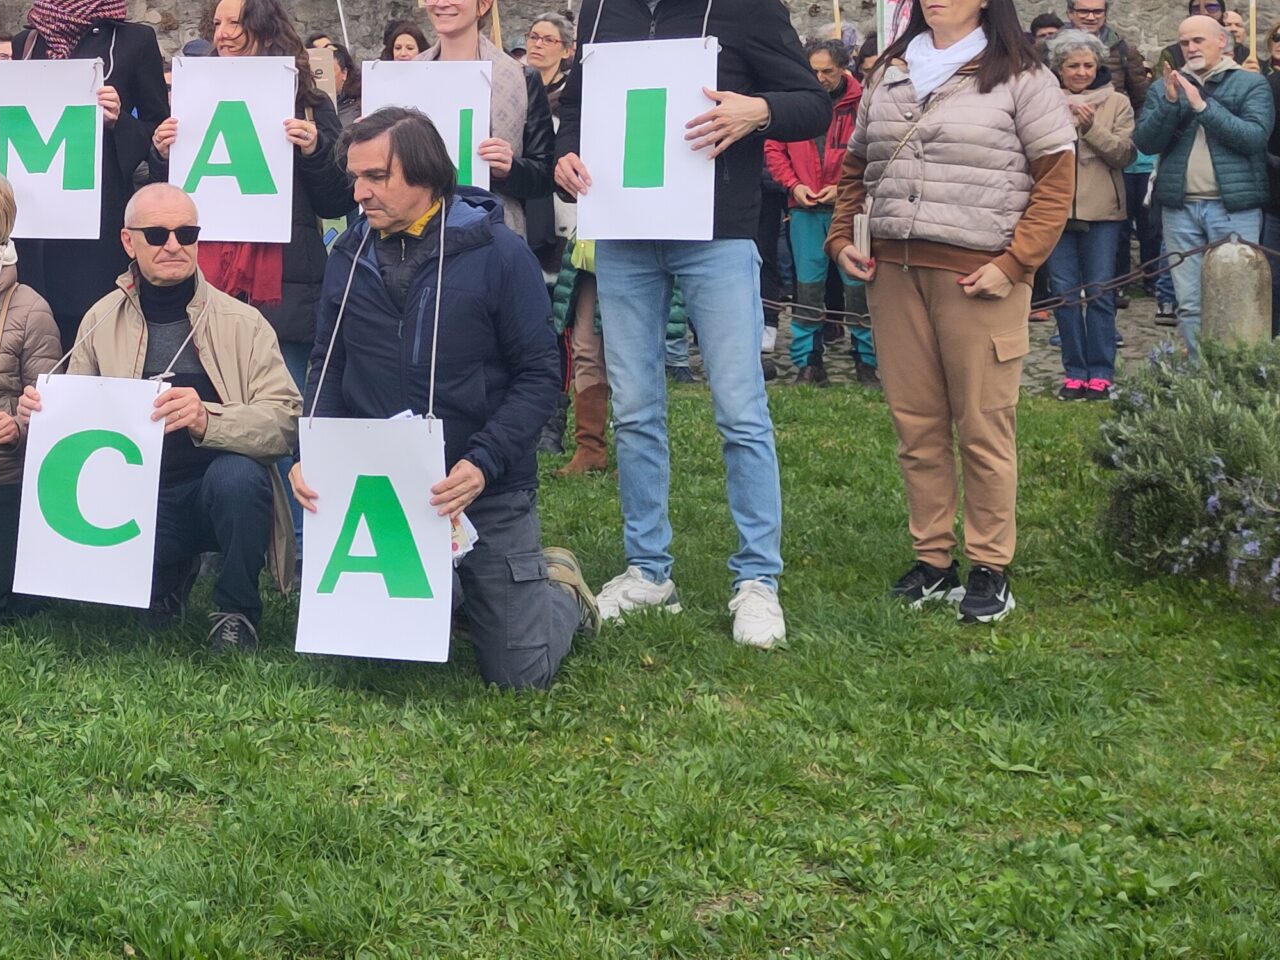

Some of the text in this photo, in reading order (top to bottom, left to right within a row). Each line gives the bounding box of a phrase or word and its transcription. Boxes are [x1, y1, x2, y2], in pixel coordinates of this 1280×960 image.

[184, 101, 277, 194] A
[623, 88, 667, 188] I
[37, 429, 143, 547] C
[317, 474, 434, 600] A
